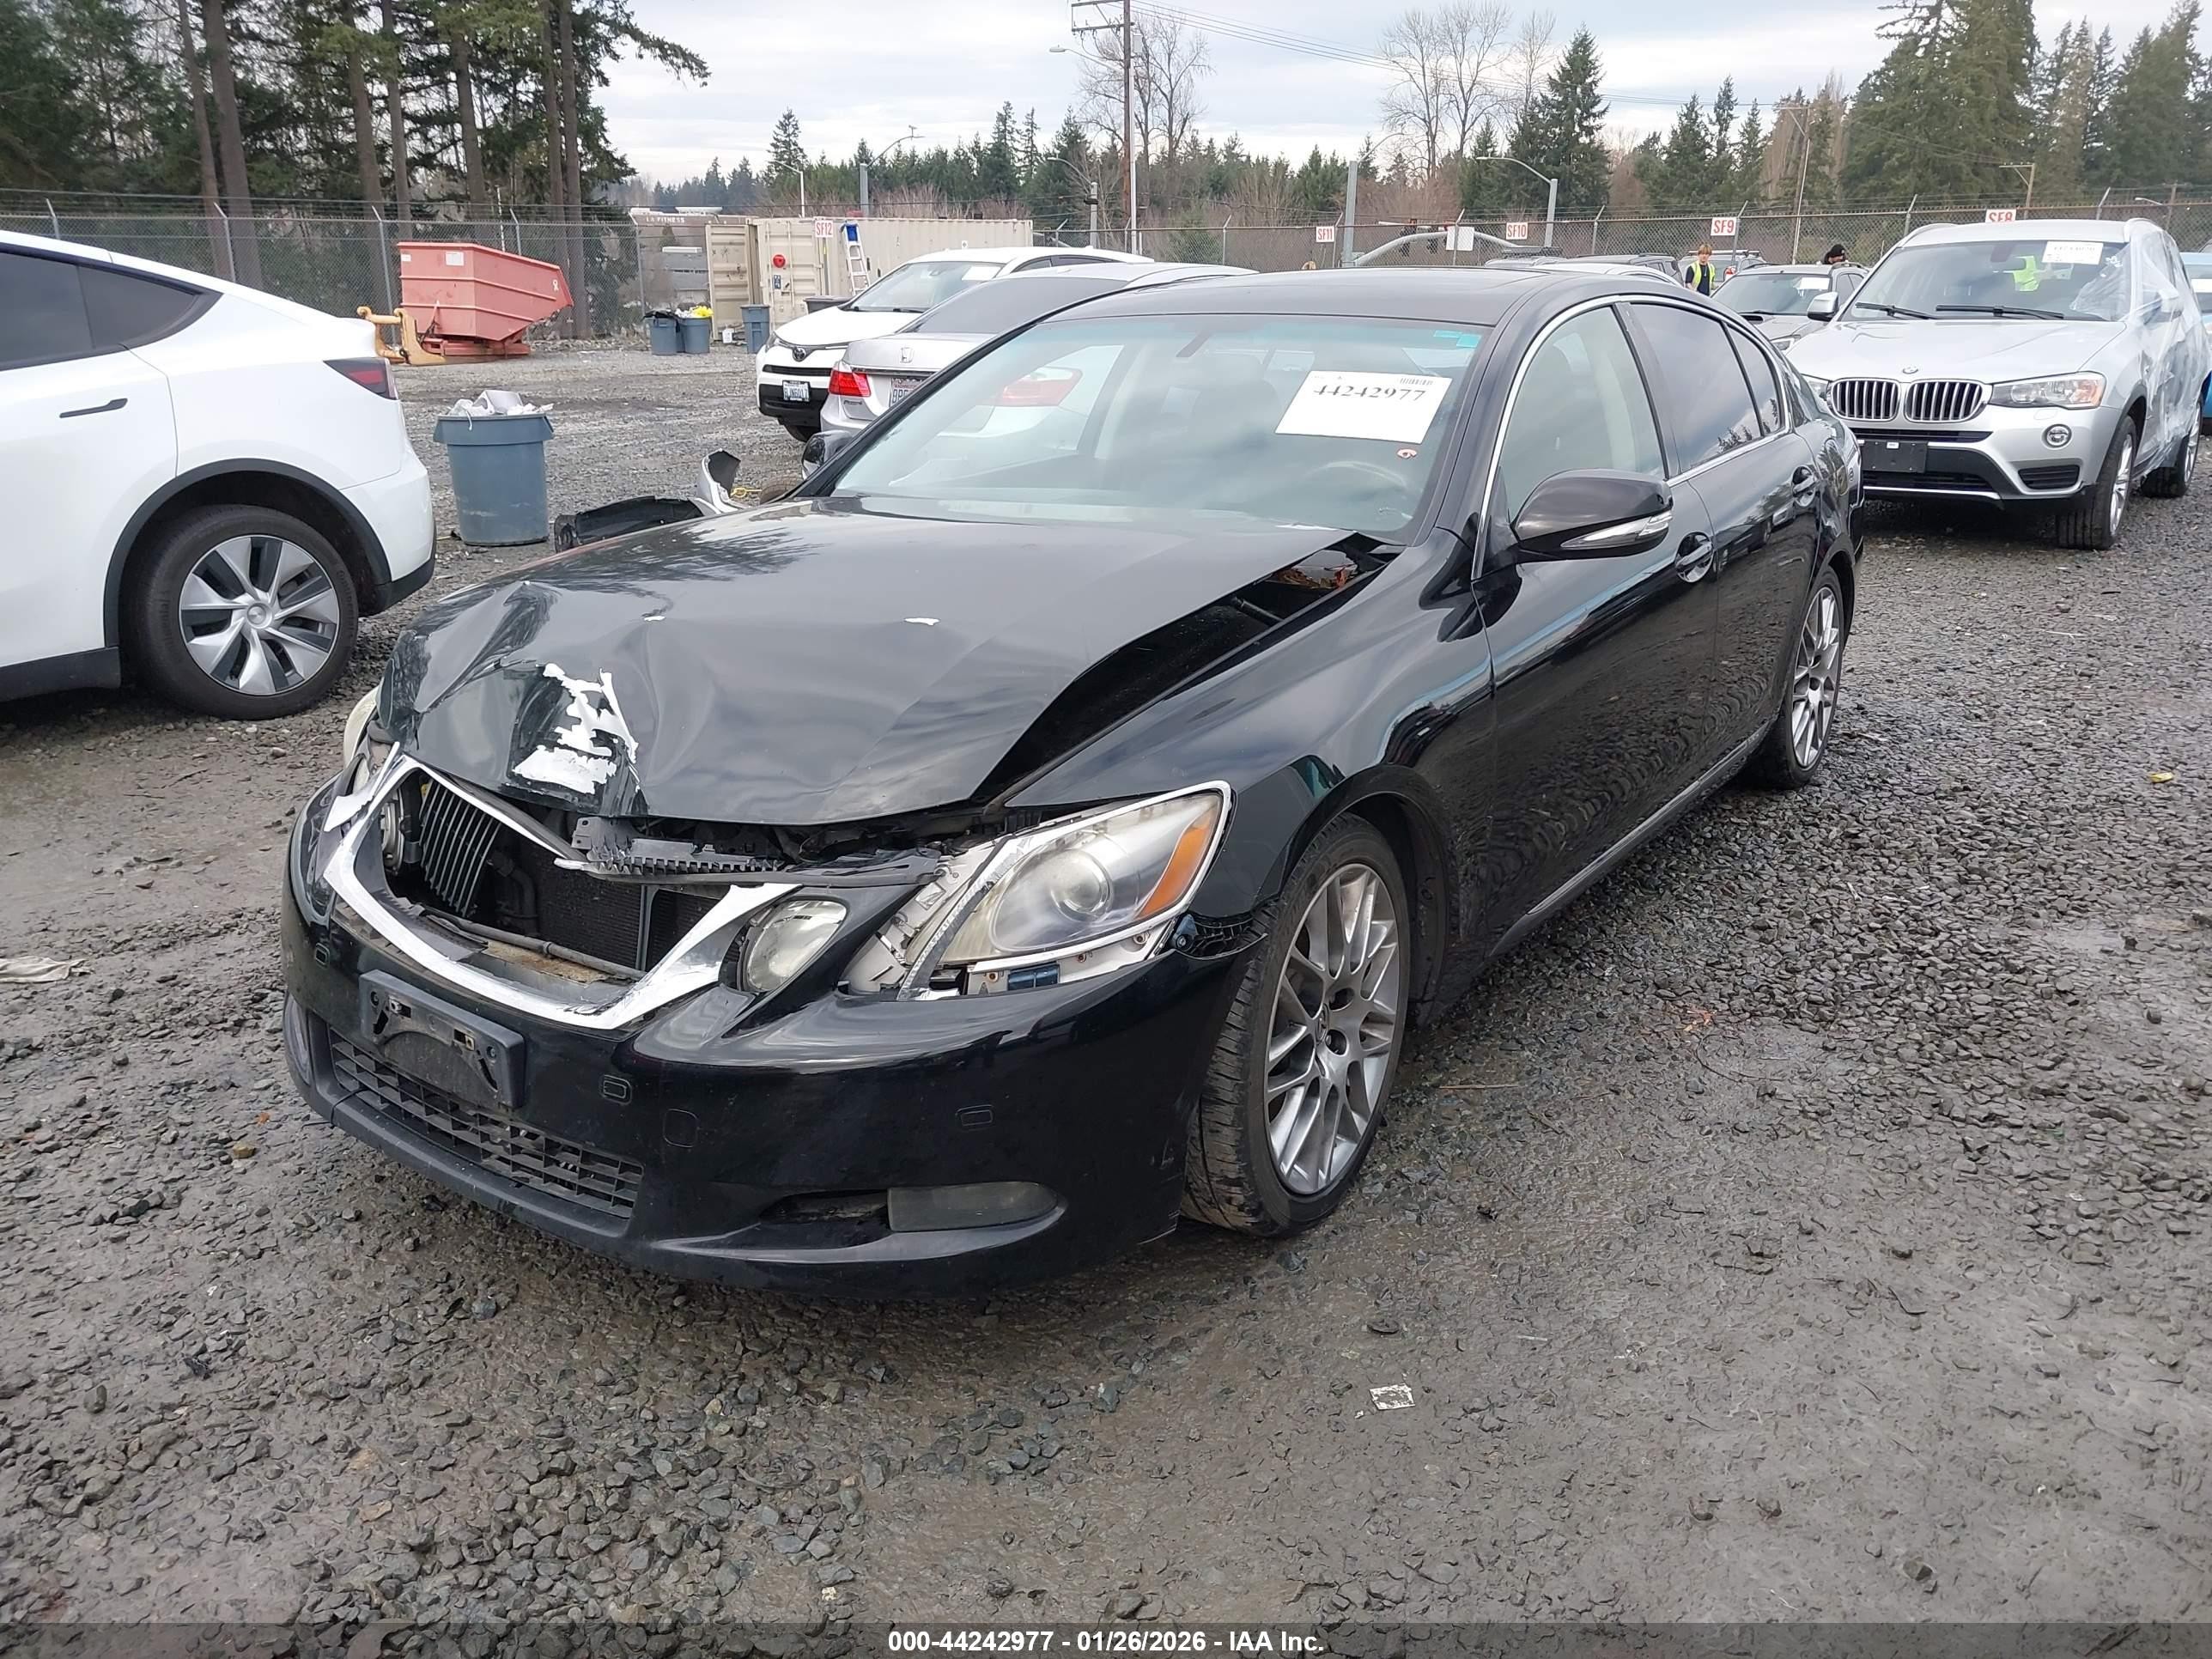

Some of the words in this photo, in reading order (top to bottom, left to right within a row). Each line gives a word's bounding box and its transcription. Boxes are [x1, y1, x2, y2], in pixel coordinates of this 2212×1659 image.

[816, 222, 832, 236] SF12
[1507, 225, 1527, 238] SF10
[1713, 219, 1735, 234] SF9
[1318, 228, 1333, 240] SF11
[1313, 385, 1426, 402] 44242977
